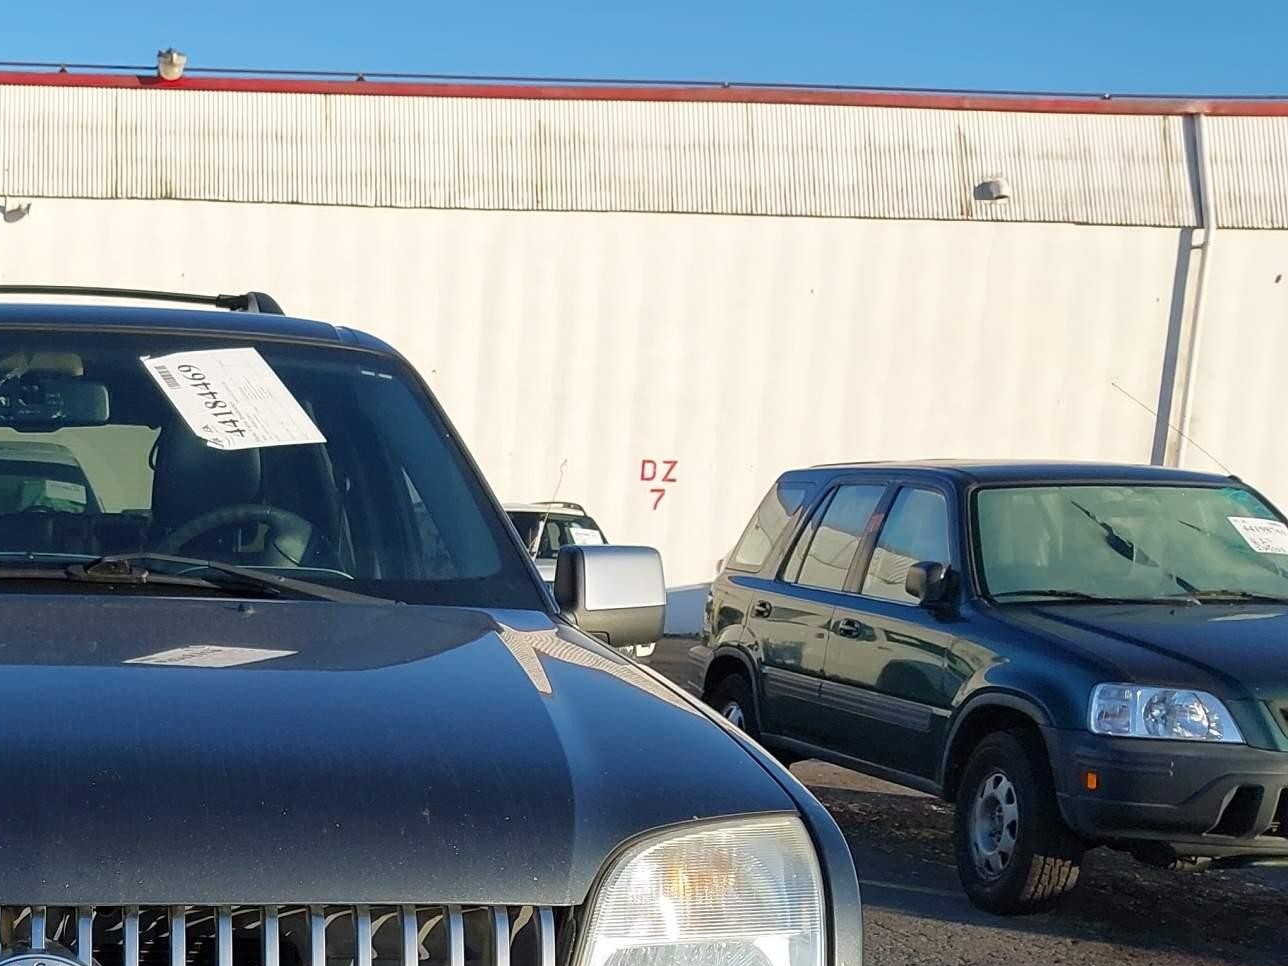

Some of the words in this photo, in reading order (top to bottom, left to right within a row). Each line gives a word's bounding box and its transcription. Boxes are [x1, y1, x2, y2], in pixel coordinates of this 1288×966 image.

[178, 364, 246, 438] 44184469
[640, 459, 678, 483] DZ
[649, 488, 666, 511] 7
